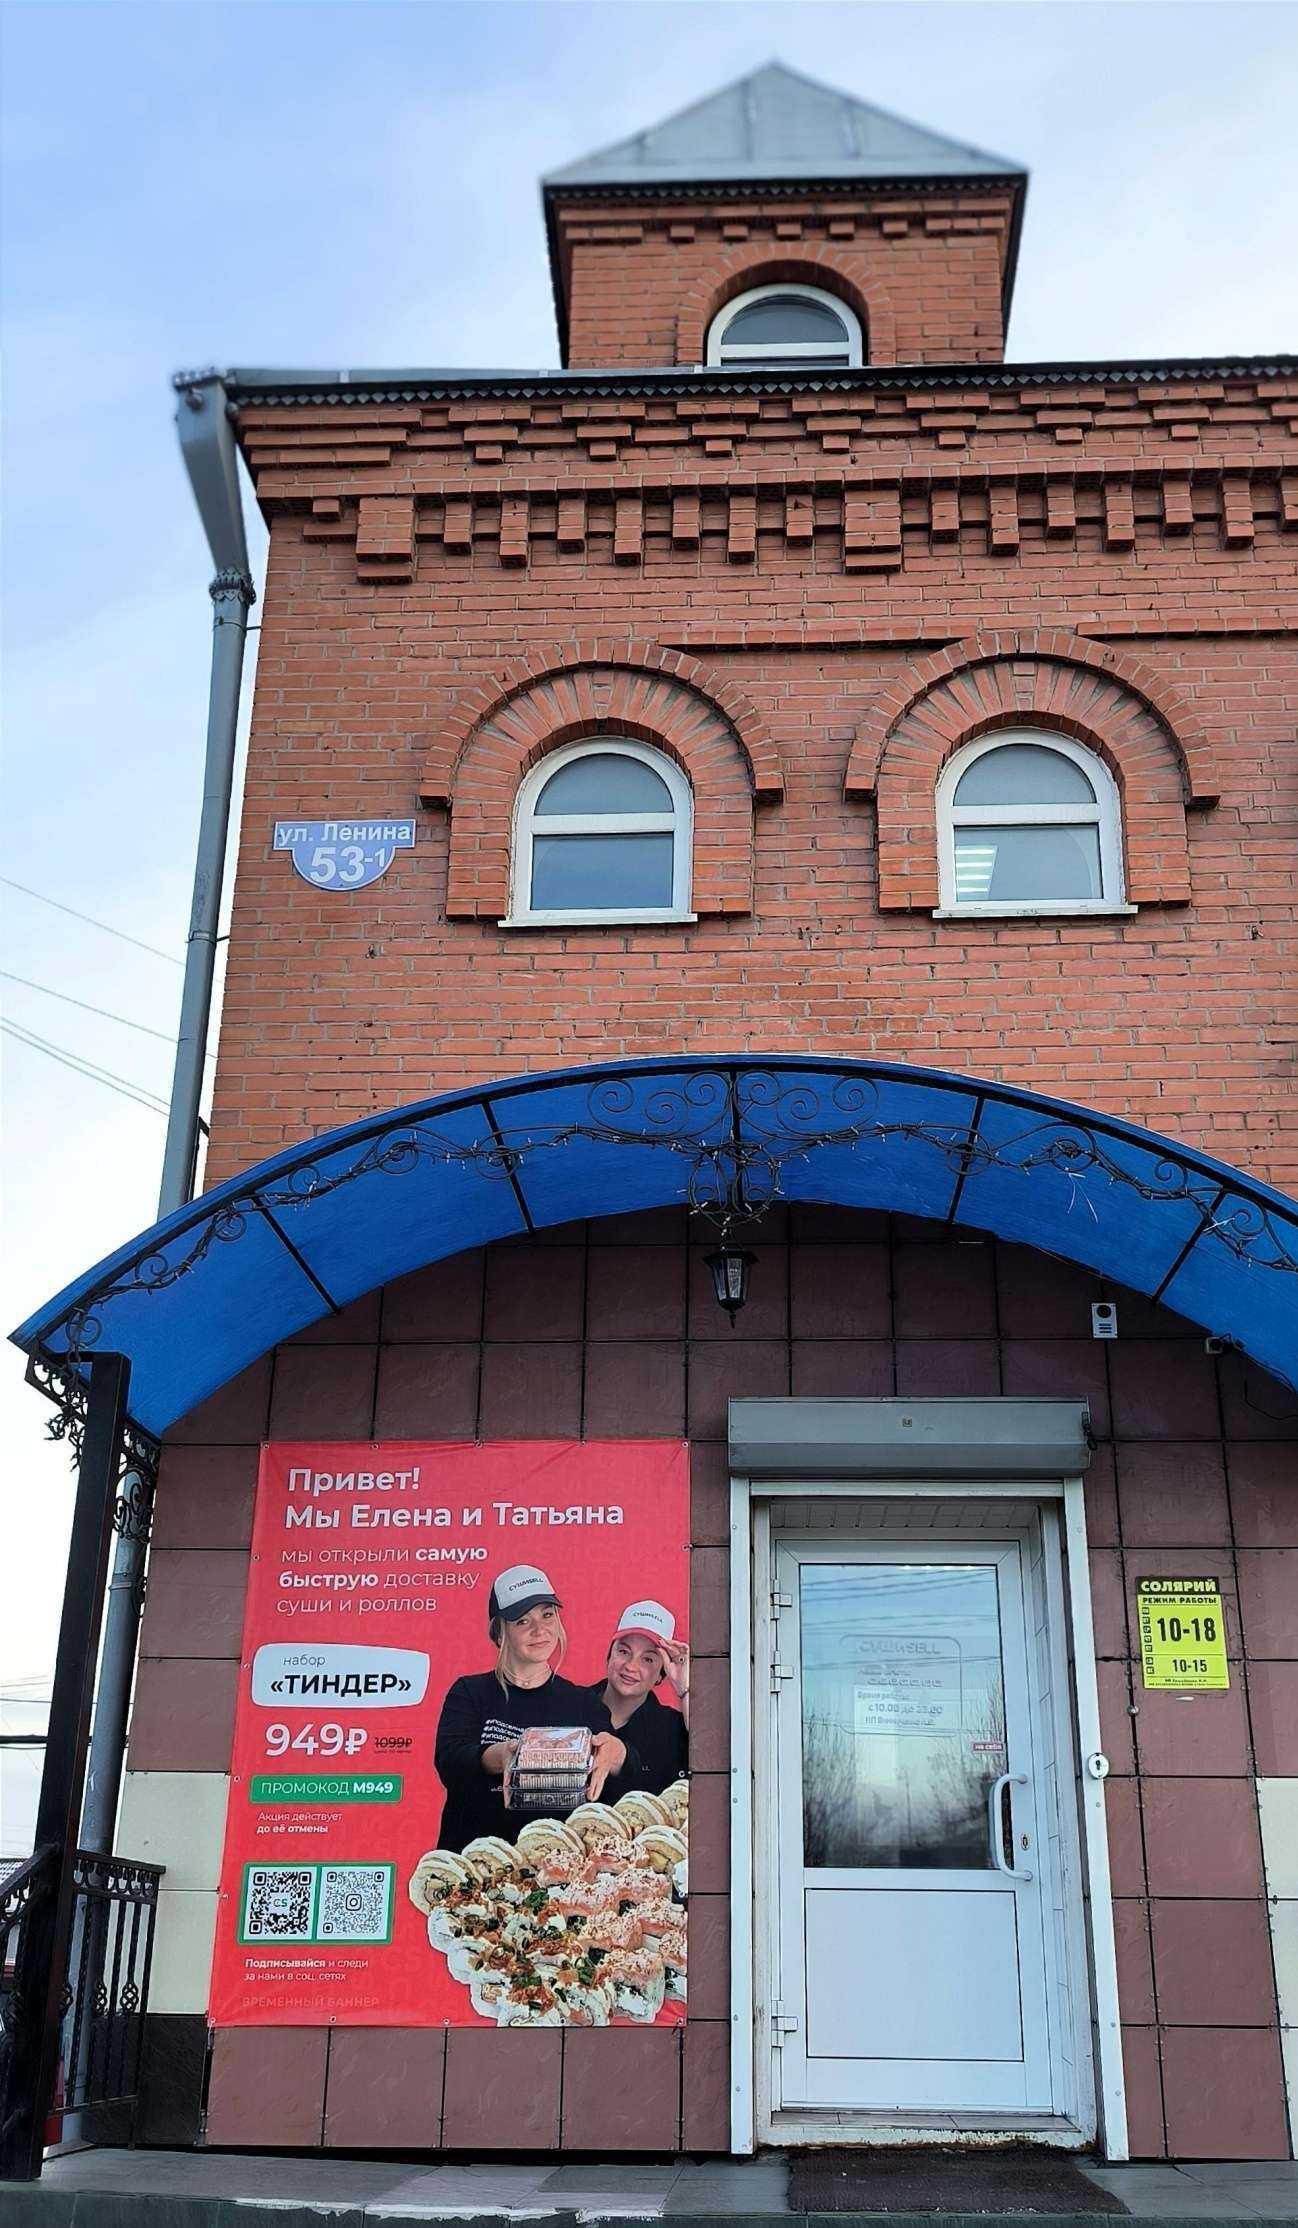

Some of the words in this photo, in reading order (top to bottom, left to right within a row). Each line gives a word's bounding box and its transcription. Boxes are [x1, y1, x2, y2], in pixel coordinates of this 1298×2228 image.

[279, 827, 313, 846] ул.
[321, 823, 411, 842] Ленина
[310, 845, 386, 883] 53-1
[288, 1467, 421, 1497] Привет!
[285, 1504, 340, 1529] Мы
[351, 1503, 451, 1528] Елена
[463, 1507, 482, 1527] и
[492, 1502, 624, 1527] Татьяна
[281, 1550, 312, 1563] мы
[319, 1548, 409, 1565] открыли
[415, 1546, 488, 1564] самую
[279, 1570, 379, 1590] быструю
[384, 1571, 480, 1590] доставку
[1141, 1578, 1217, 1592] СОЛЯРИЙ
[276, 1599, 332, 1617] суши
[339, 1598, 351, 1613] и
[358, 1597, 437, 1615] роллов
[1142, 1596, 1177, 1604] РЕЖИМ
[1180, 1596, 1217, 1604] РАБОТЫ
[1157, 1617, 1216, 1642] 10-18
[283, 1653, 326, 1668] набор
[1172, 1658, 1208, 1673] 10-15
[270, 1673, 412, 1697] «ТИНДЕР»
[265, 1723, 368, 1756] 949₽
[261, 1781, 349, 1796] ПРОМОКОД
[257, 1811, 290, 1823] Акция
[292, 1811, 343, 1823] действует
[257, 1825, 271, 1834] до
[273, 1823, 286, 1833] её
[288, 1824, 328, 1834] отмены
[245, 1958, 326, 1969] Подписывайся
[328, 1959, 335, 1968] и
[337, 1959, 369, 1969] следи
[244, 1972, 256, 1981] за
[257, 1972, 285, 1981] нами
[287, 1972, 294, 1981] в
[319, 1972, 346, 1981] сетях
[327, 1996, 380, 2008] БАННЕР
